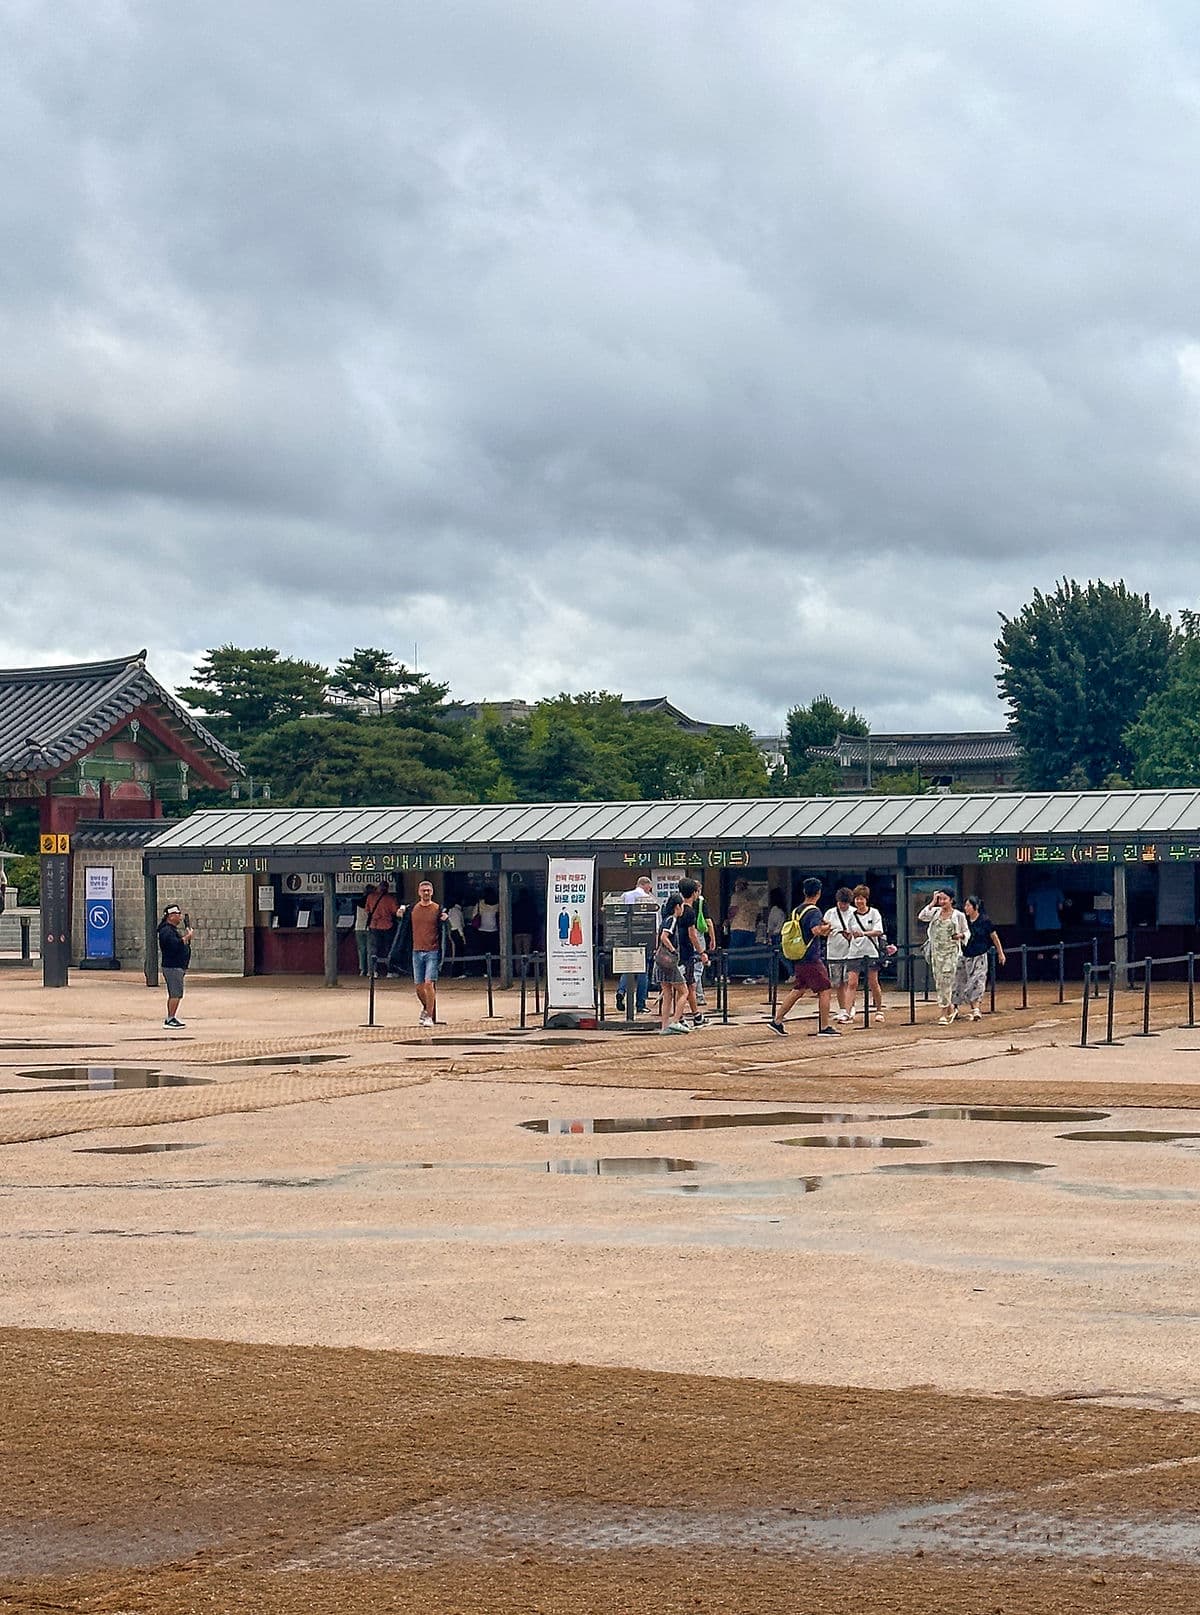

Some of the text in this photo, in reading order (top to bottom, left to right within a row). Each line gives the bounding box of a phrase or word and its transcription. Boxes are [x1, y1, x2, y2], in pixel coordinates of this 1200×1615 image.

[658, 851, 702, 866] 매표소
[1016, 846, 1066, 862] 매표소
[306, 872, 341, 884] Tout
